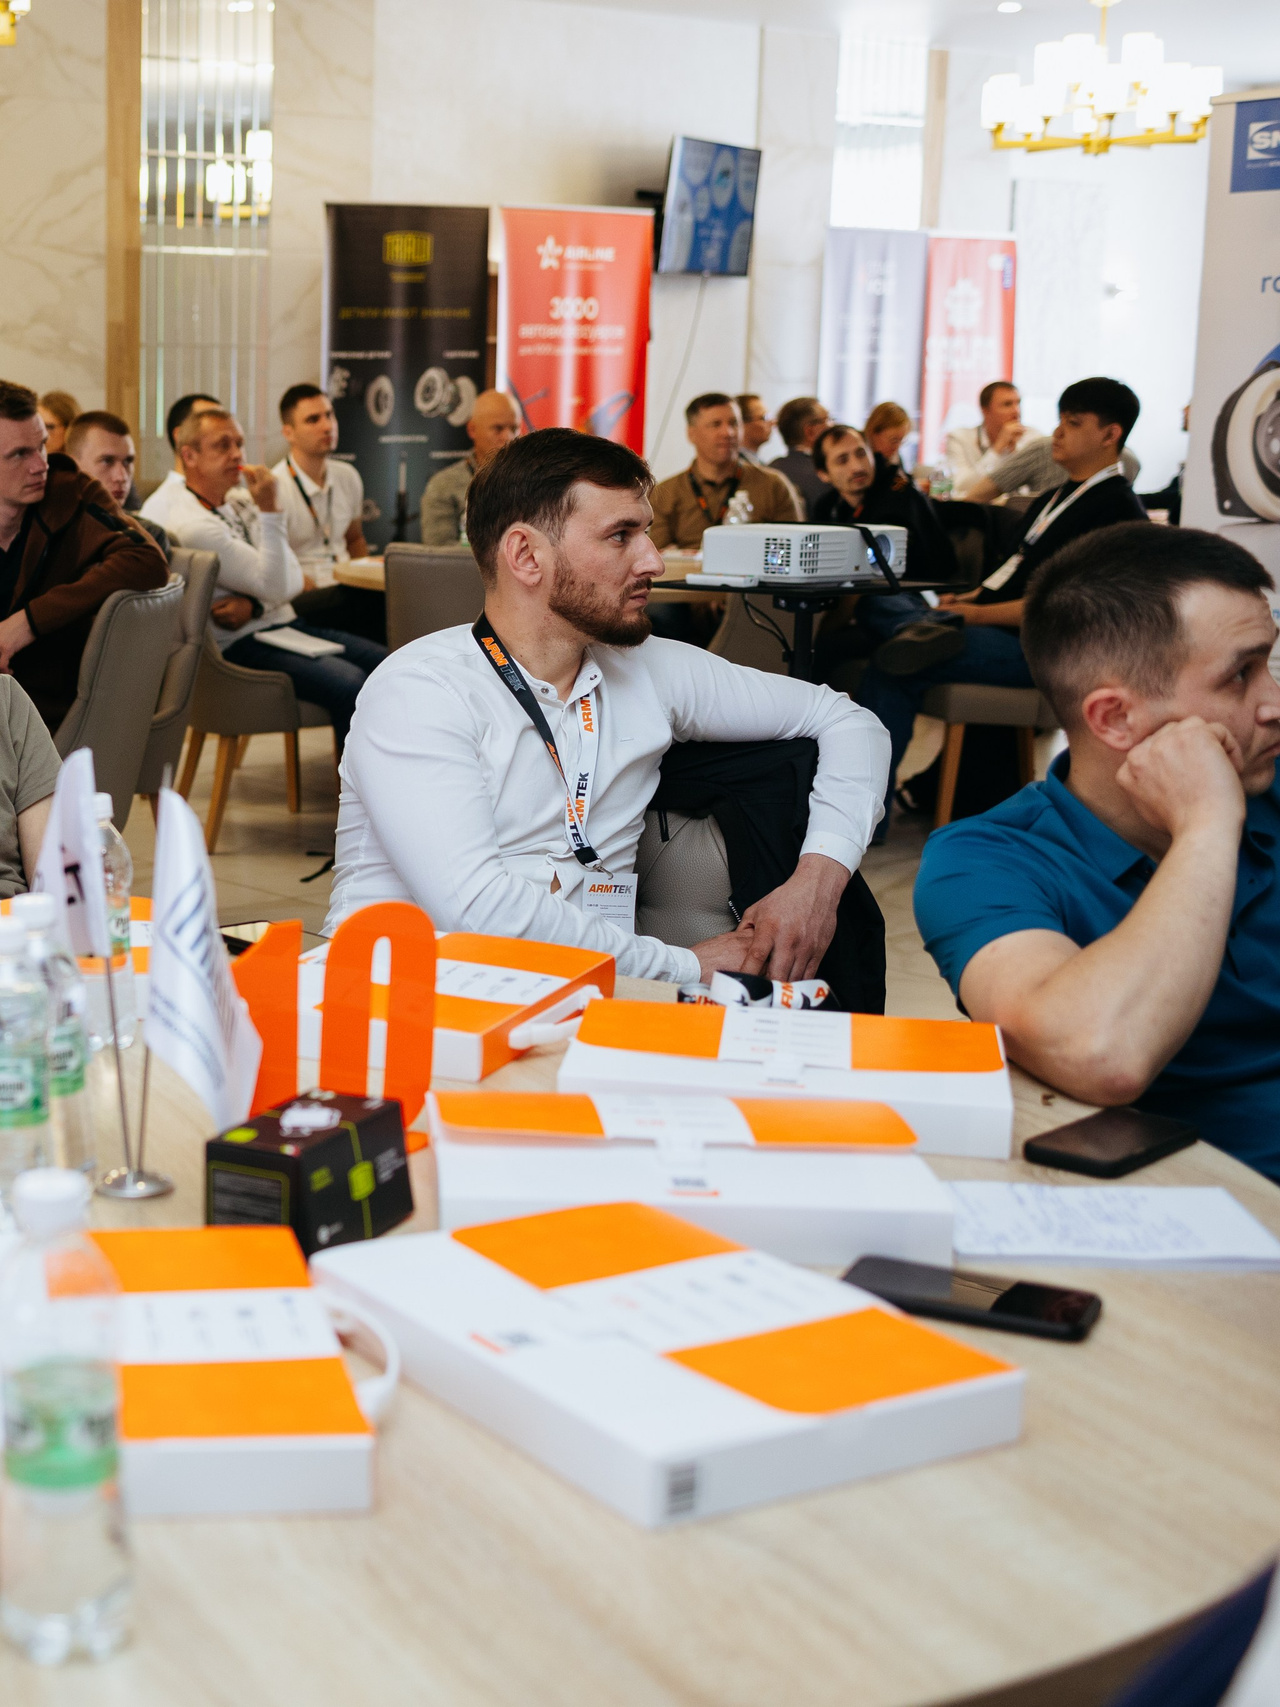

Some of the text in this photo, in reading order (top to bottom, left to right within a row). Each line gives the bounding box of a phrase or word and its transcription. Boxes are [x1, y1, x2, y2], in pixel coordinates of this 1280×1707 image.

[481, 637, 526, 692] ARMTEK
[575, 772, 589, 825] RMTEK
[588, 883, 633, 894] ARMTEK
